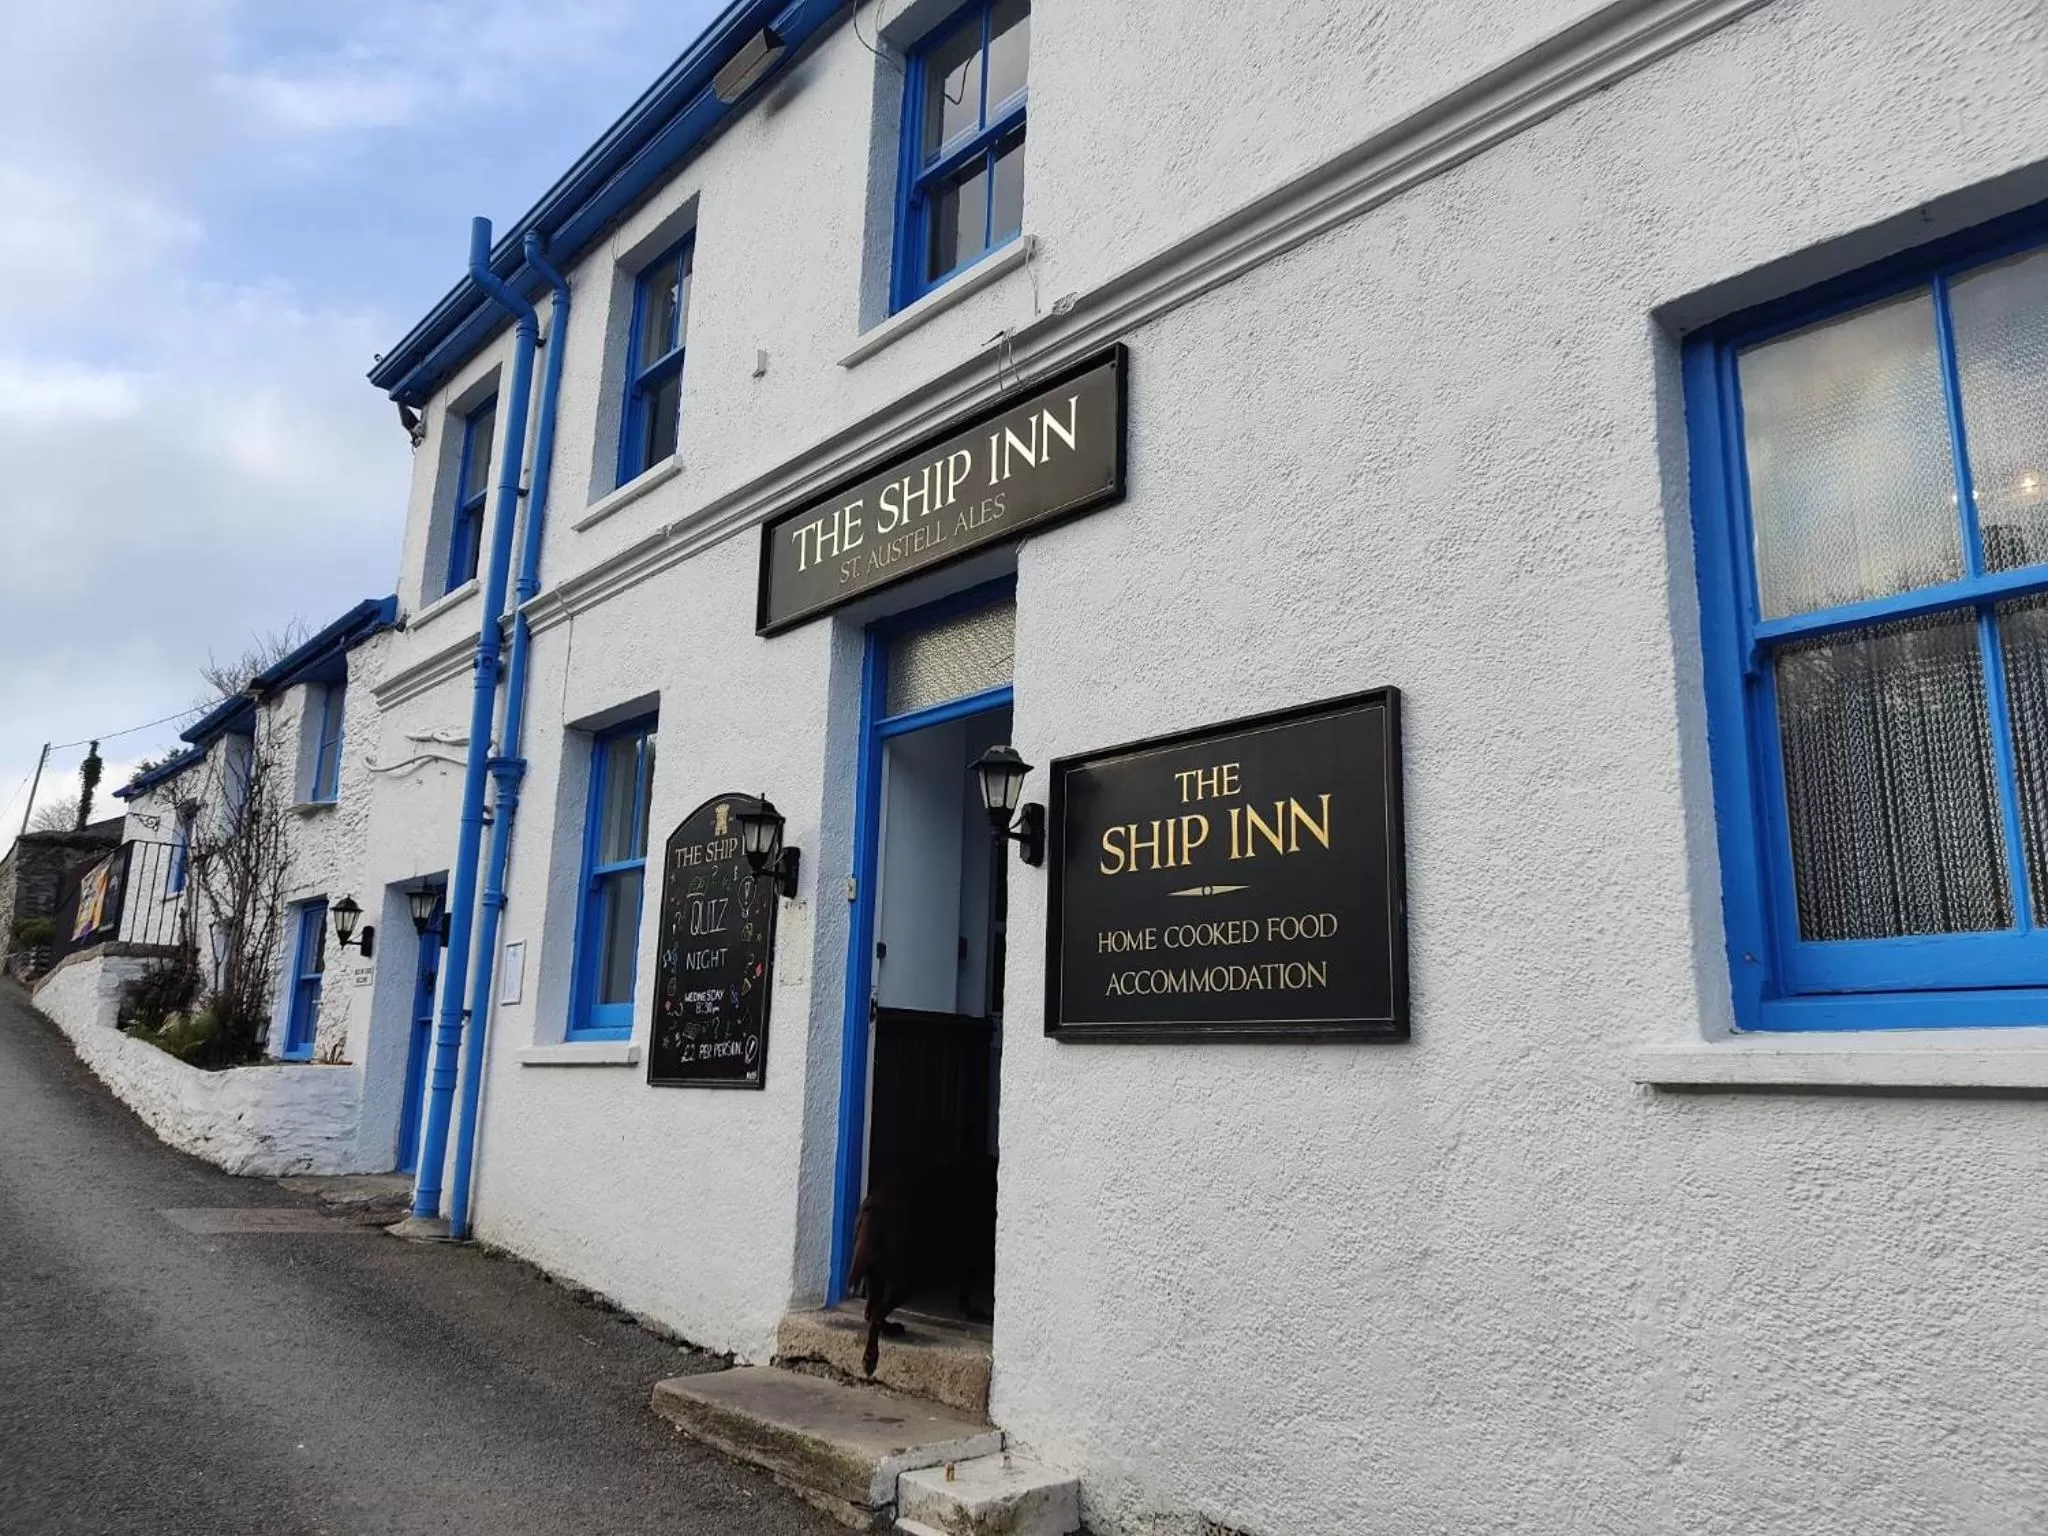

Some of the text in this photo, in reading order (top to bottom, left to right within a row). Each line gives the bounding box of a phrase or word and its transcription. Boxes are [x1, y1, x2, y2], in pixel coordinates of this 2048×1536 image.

[792, 394, 1081, 572] THE SHIP INN
[839, 492, 1007, 585] ST. AUSTELL ALES
[1175, 762, 1243, 804] THE
[675, 844, 703, 868] THE
[705, 838, 738, 863] SHIP
[1099, 792, 1333, 876] SHIP INN
[690, 897, 729, 936] QUIZ
[1097, 912, 1338, 954] HOME COOKED FOOD
[686, 948, 728, 971] NIGHT
[1104, 960, 1328, 996] ACCOMMODATION
[684, 989, 725, 1003] WEDNESDAY
[699, 1045, 712, 1060] PER
